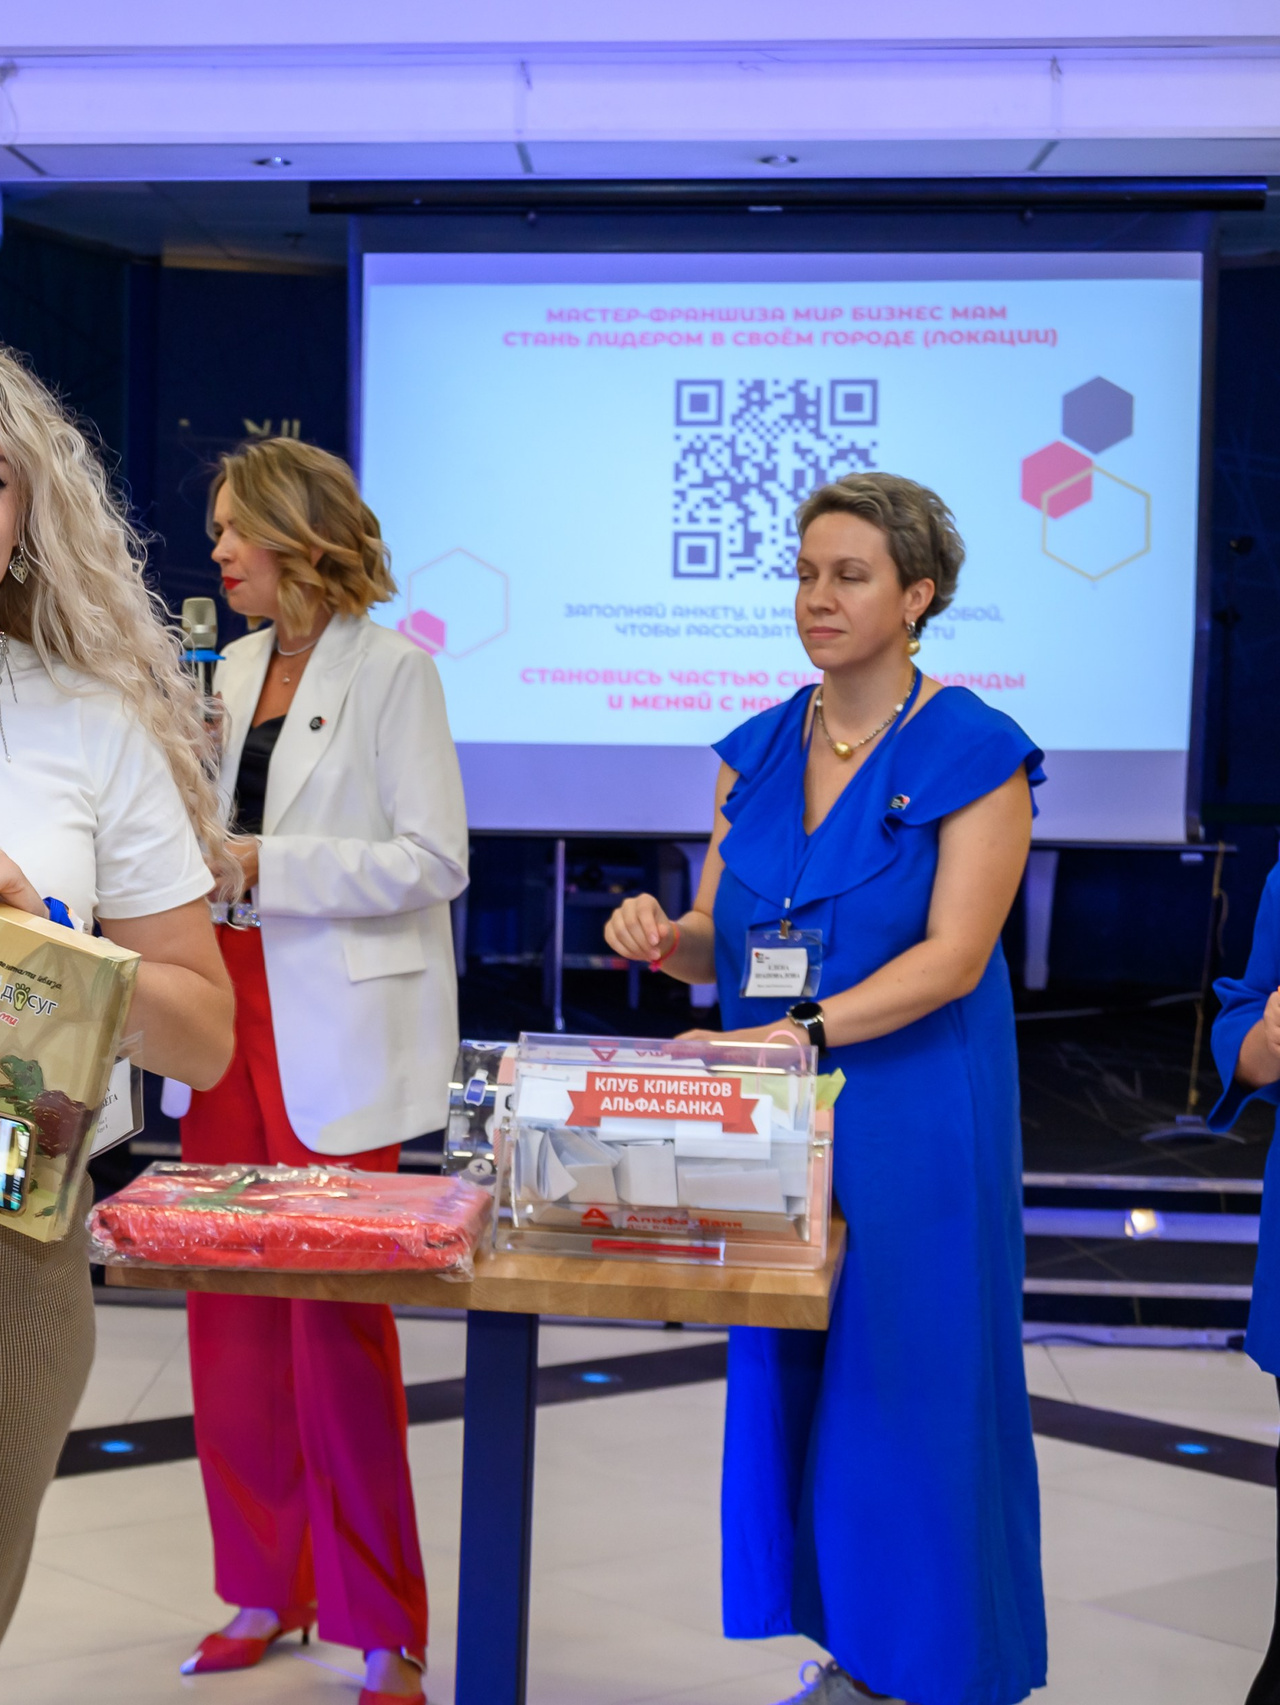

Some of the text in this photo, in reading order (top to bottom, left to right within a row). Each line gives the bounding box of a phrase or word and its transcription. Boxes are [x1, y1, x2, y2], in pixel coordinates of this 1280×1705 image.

[546, 305, 1008, 323] МАСТЕР-ФРАНШИЗА МИР БИЗНЕС МАМ
[503, 326, 1058, 349] СТАНЬ ЛИДЕРОМ В СВОЁМ ГОРОДЕ (ЛОКАЦИИ)
[564, 602, 667, 619] ЗАПОЛНЯЙ
[940, 603, 1005, 622] ОБОЙ,
[615, 623, 681, 638] ЧТОБЫ
[520, 668, 663, 685] СТАНОВИСЬ
[669, 670, 769, 687] ЧАСТЬЮ
[931, 673, 1025, 692] МАНДЫ
[608, 695, 623, 710] И
[631, 692, 712, 711] МЕНЯЙ
[719, 696, 733, 711] С
[594, 1076, 733, 1098] КЛУБ КЛИЕНТОВ
